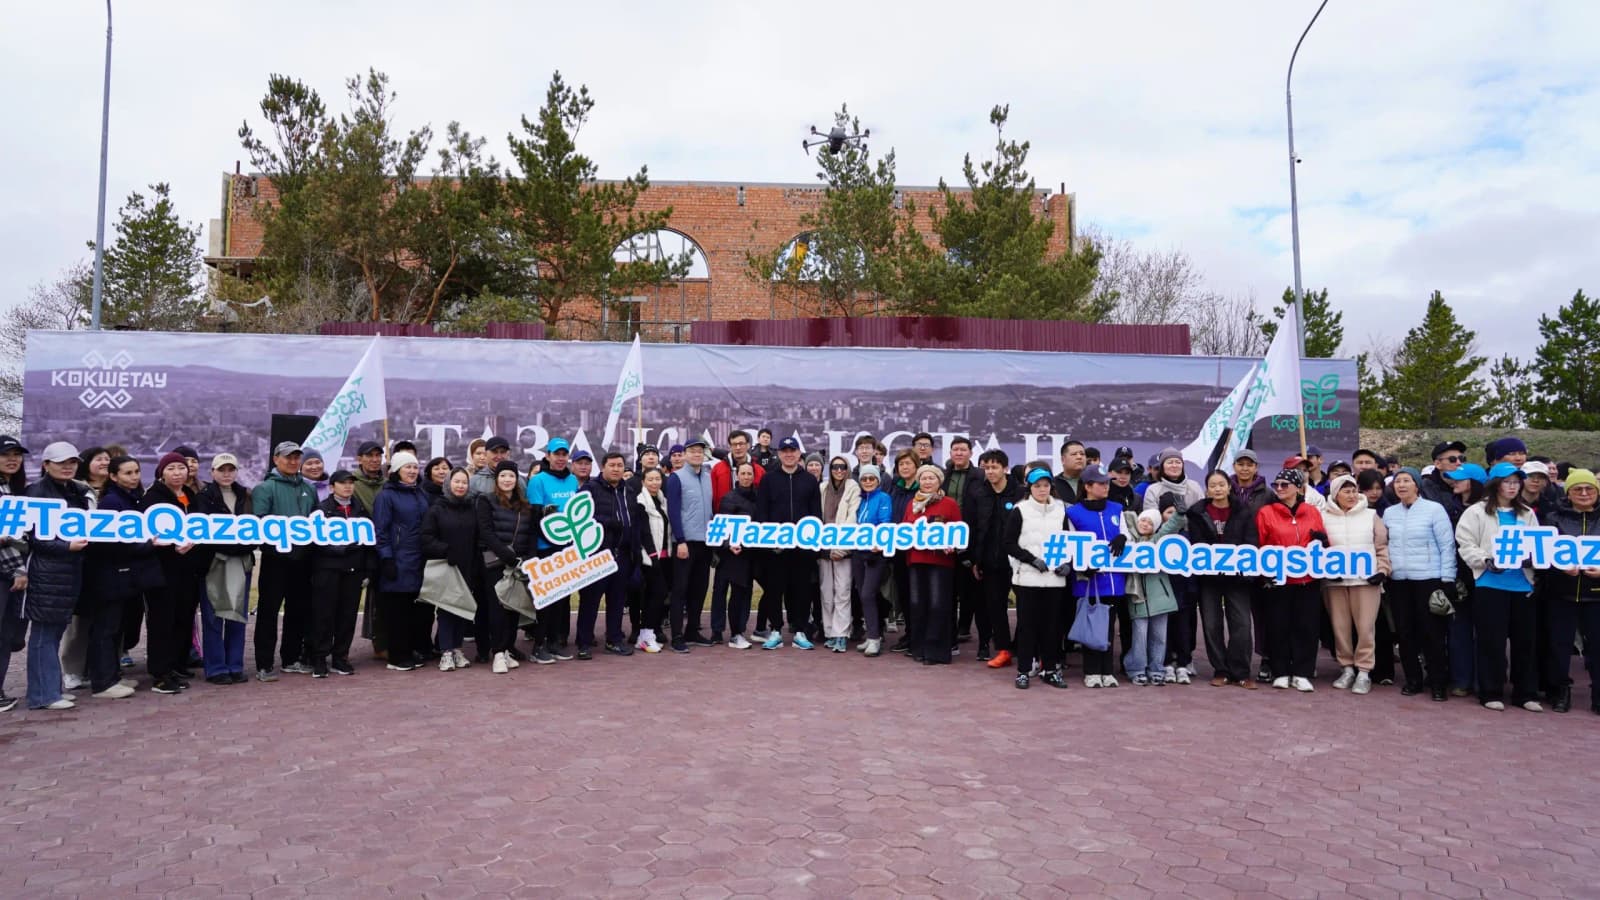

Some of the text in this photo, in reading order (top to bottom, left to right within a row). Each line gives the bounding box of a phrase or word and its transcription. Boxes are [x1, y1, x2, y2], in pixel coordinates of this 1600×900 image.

[0, 499, 375, 549] #TazaQazaqstan
[708, 517, 967, 553] #TazaQazaqstan
[525, 549, 578, 580] Таза
[1043, 534, 1373, 581] #TazaQazaqstan
[1495, 530, 1600, 565] #Taz
[532, 553, 611, 596] Қазақстан
